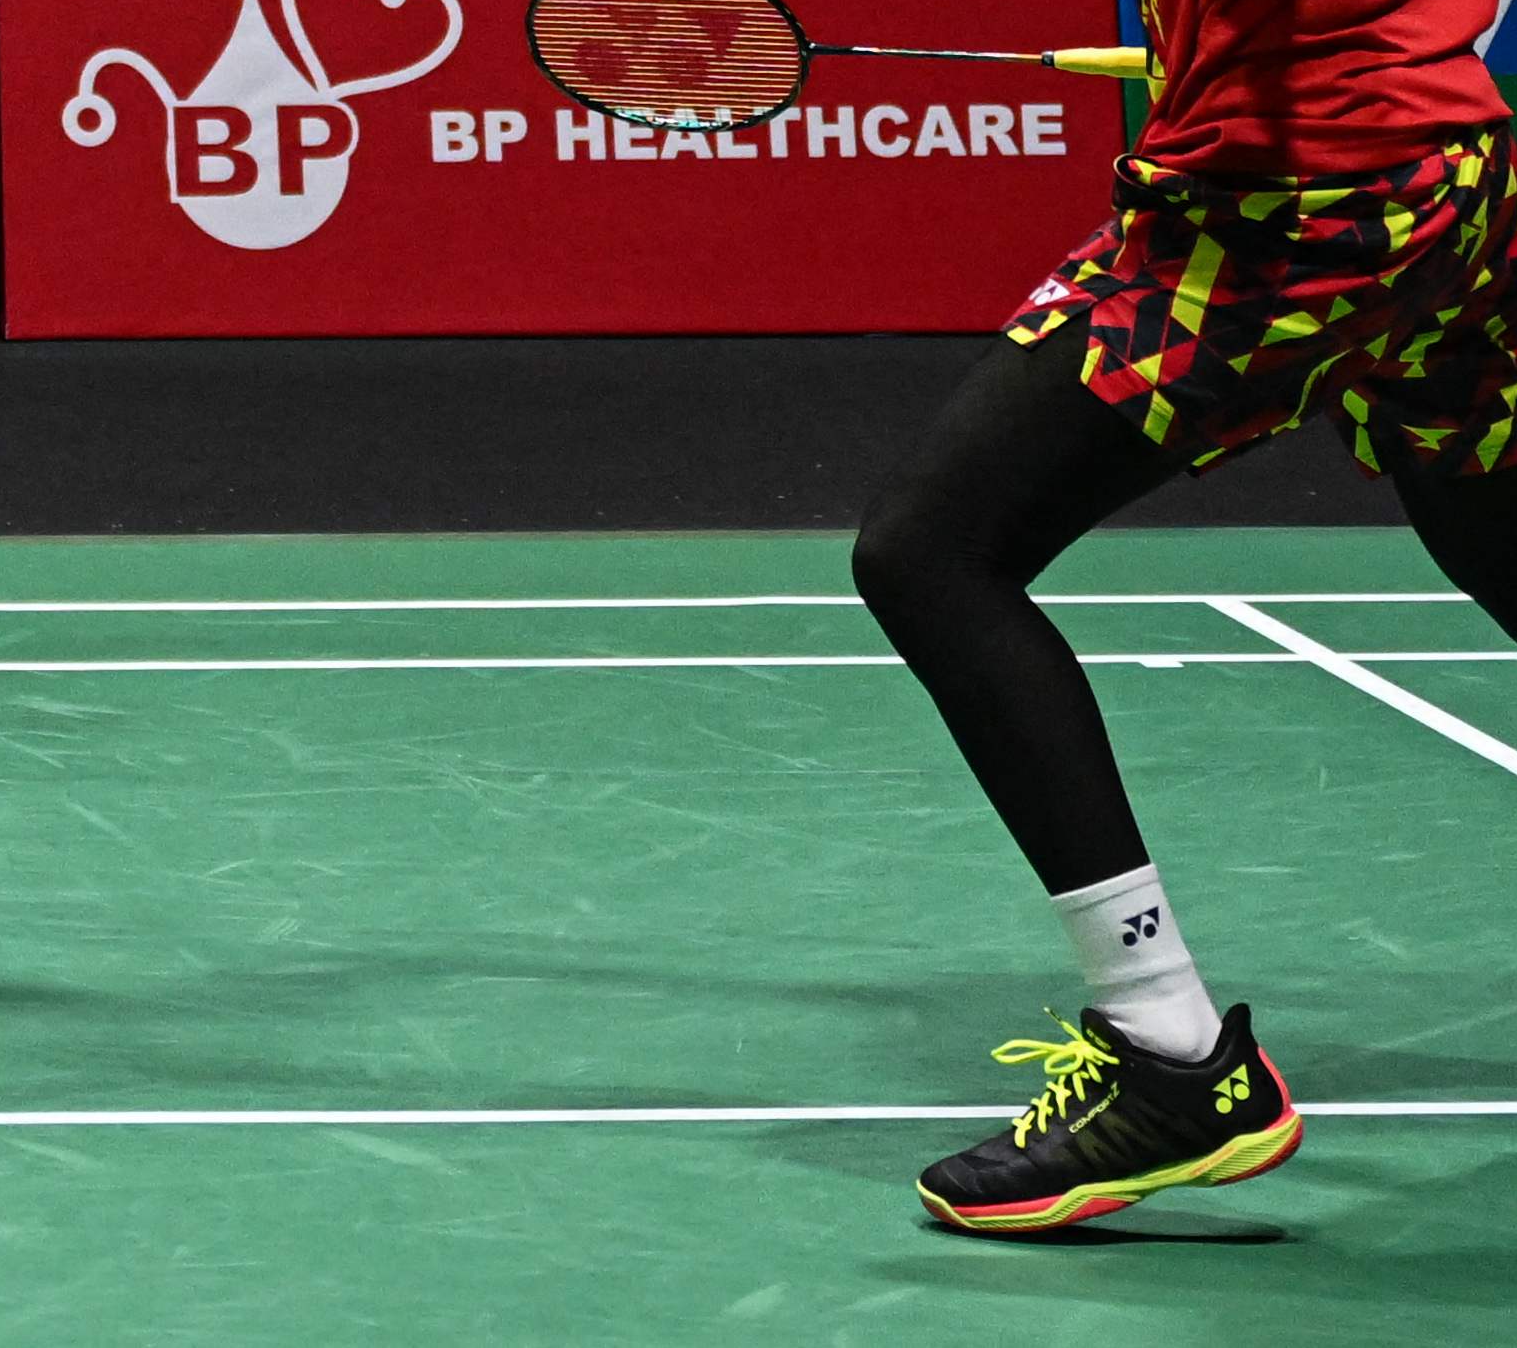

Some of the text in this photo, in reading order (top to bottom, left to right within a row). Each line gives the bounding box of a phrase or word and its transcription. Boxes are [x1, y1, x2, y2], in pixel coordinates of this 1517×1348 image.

[173, 104, 354, 197] BP
[430, 103, 1067, 163] BP HEALTHCARE
